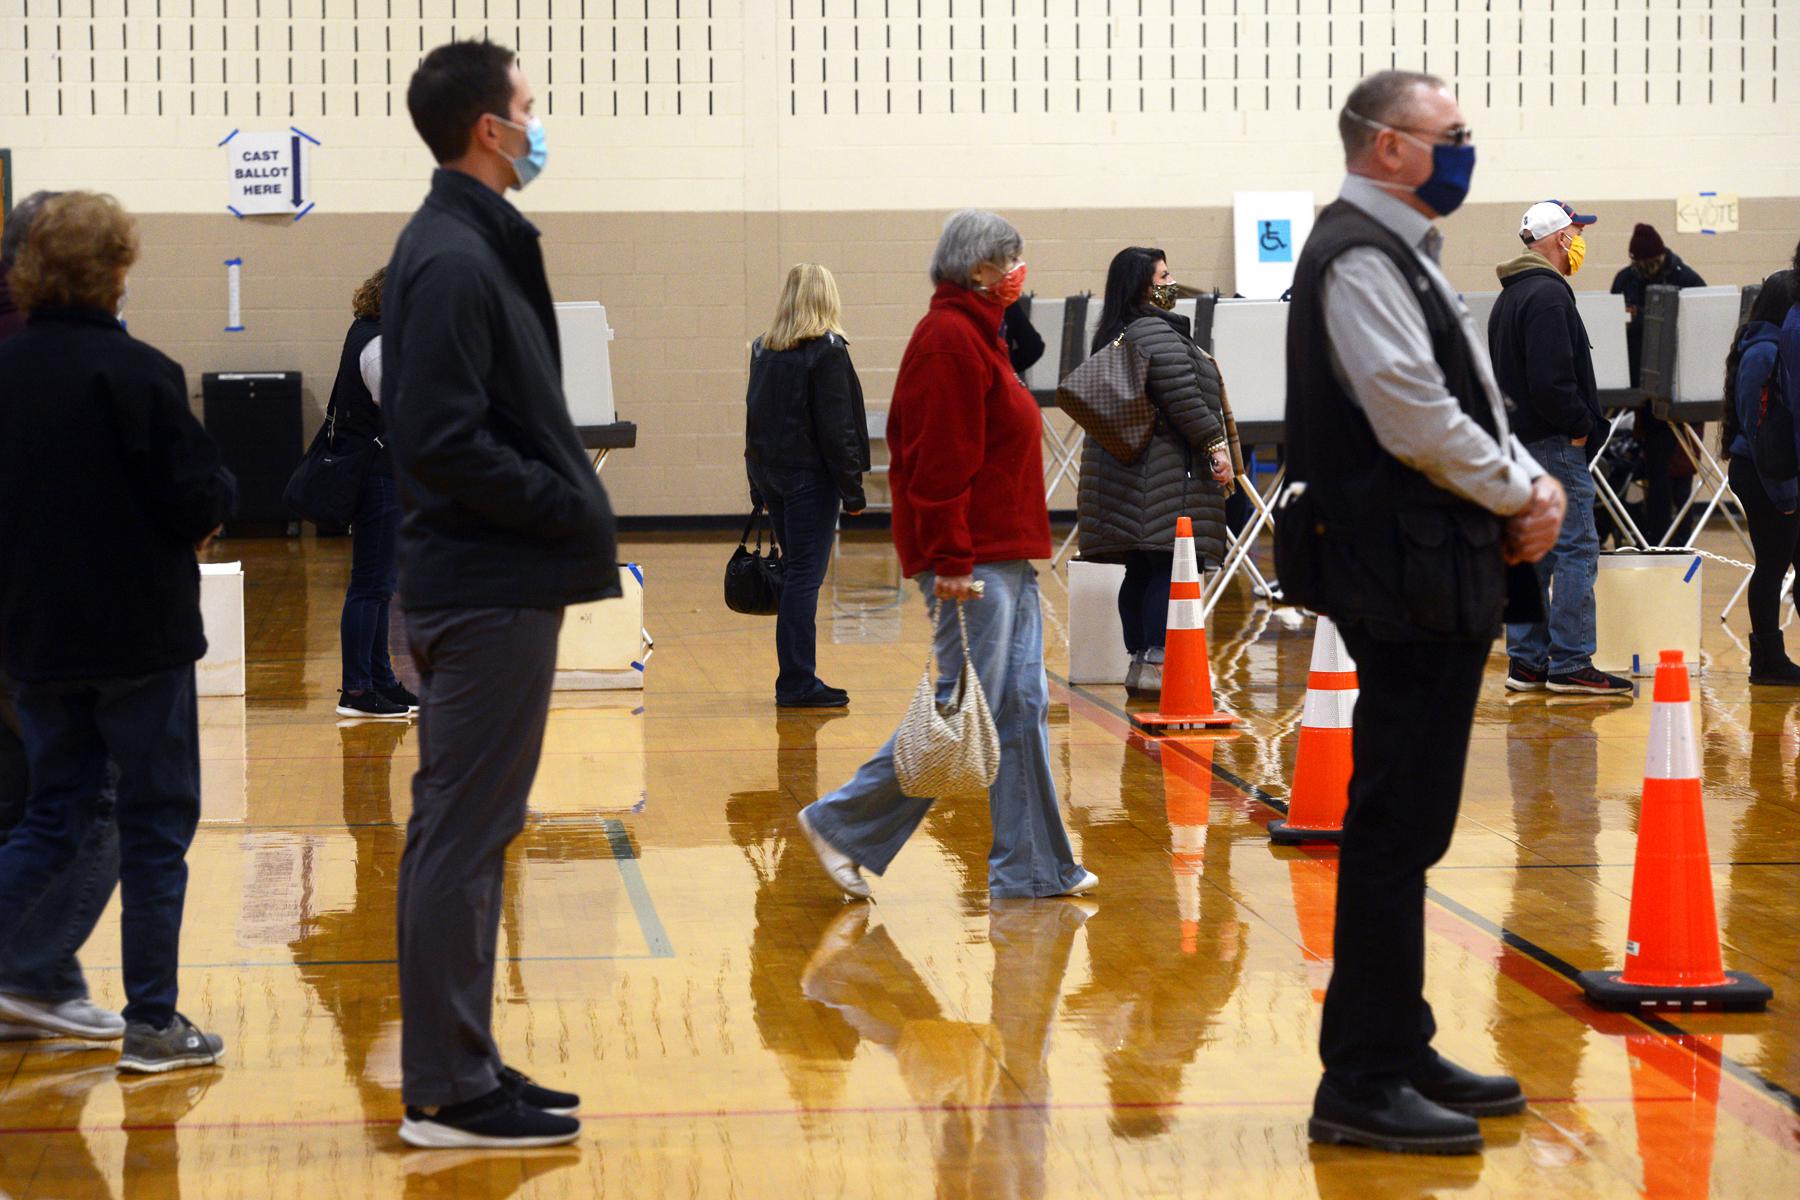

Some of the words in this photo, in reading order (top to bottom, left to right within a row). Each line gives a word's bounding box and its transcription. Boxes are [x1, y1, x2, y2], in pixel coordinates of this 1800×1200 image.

[242, 150, 279, 162] CAST
[234, 167, 289, 179] BALLOT
[243, 184, 282, 195] HERE
[1695, 202, 1737, 226] VOTE
